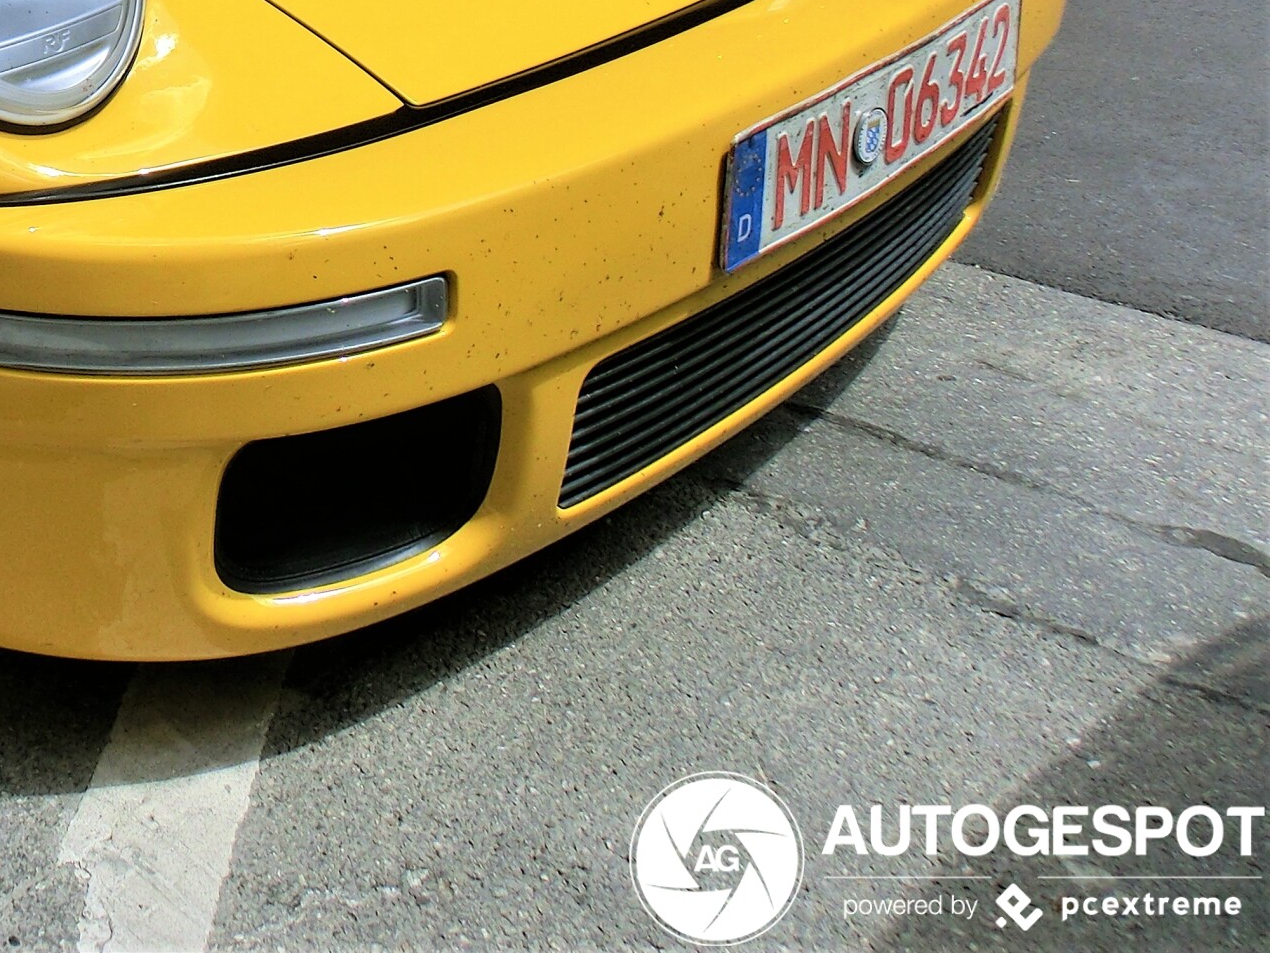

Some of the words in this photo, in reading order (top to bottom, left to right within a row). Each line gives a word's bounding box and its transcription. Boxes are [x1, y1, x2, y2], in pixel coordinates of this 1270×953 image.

[771, 96, 851, 232] MN
[884, 2, 1012, 166] 06342
[736, 212, 752, 243] D
